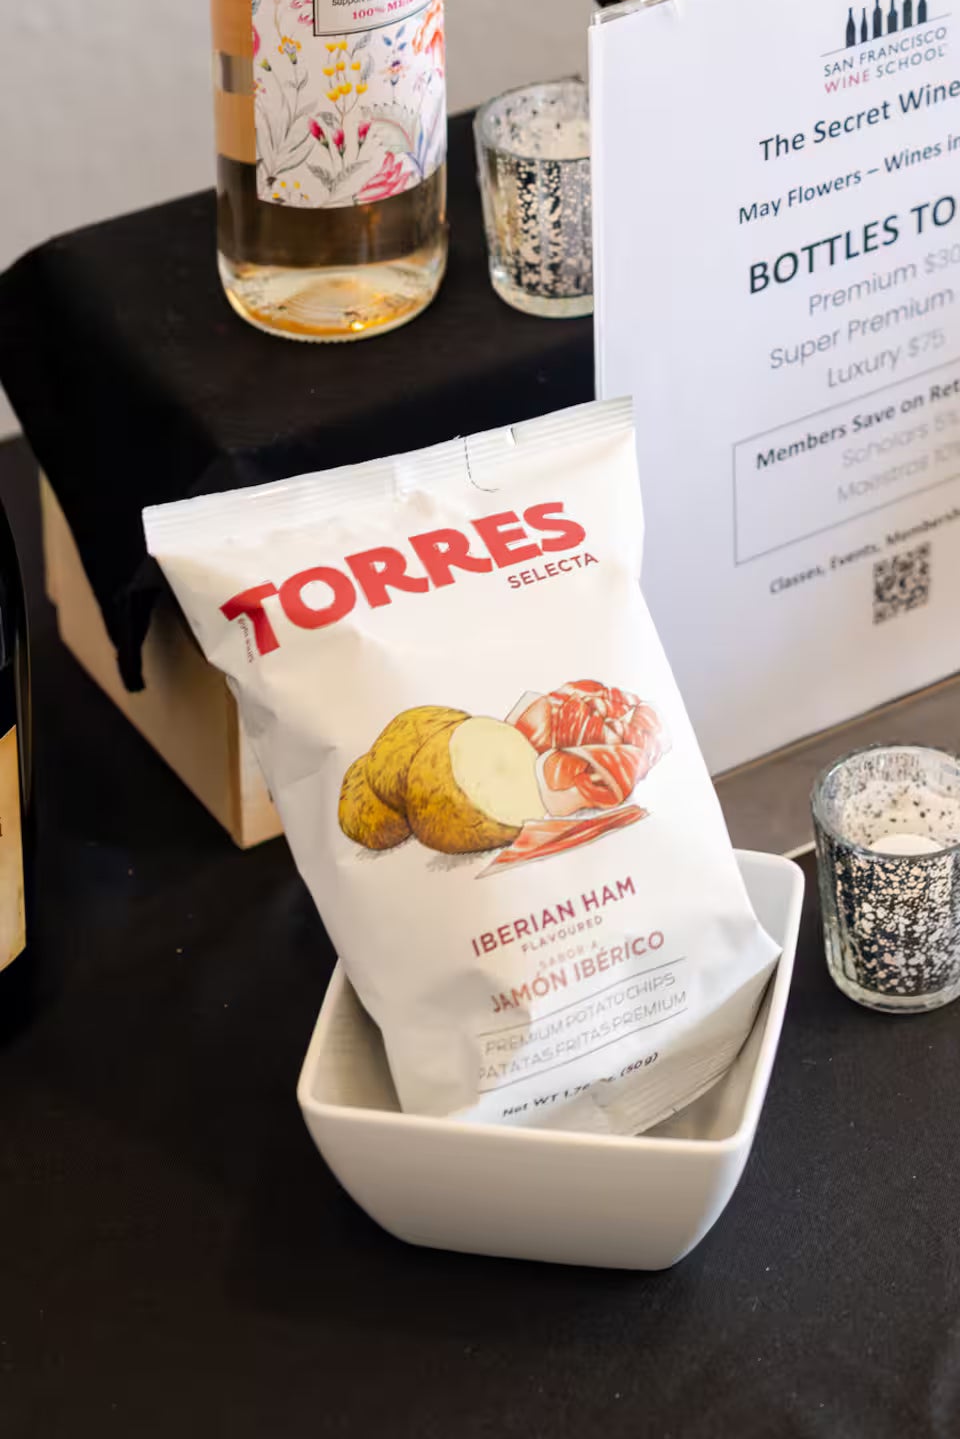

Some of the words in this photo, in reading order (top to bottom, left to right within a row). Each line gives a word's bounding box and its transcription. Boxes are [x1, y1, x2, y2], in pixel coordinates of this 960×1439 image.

[823, 57, 854, 77] SAN
[859, 26, 947, 66] FRANCISCO
[824, 70, 870, 94] WINE
[759, 132, 805, 161] The
[813, 100, 891, 144] Secret
[899, 78, 960, 114] Wine
[738, 197, 782, 224] May
[787, 170, 862, 208] Flowers
[884, 141, 942, 173] Wines
[749, 214, 899, 294] BOTTLES
[910, 195, 956, 235] TO
[808, 262, 917, 316] Premium
[769, 327, 840, 371] Super
[847, 287, 955, 341] Premium
[826, 343, 901, 388] Luxury
[907, 327, 946, 360] $75
[755, 426, 847, 470] Members
[852, 404, 896, 434] Save
[900, 393, 925, 416] on
[219, 501, 587, 657] TORRES
[507, 551, 600, 589] SELECTA
[769, 567, 826, 595] Classes,
[830, 543, 880, 570] Events,
[471, 899, 577, 958] IBERIAN
[581, 876, 637, 912] HAM
[521, 915, 604, 953] FLAVOURED
[490, 968, 569, 1013] JAMÓN
[573, 930, 666, 982] IBÉRICO
[538, 944, 586, 970] SABOR
[478, 1045, 555, 1081] PATATAS
[555, 1024, 612, 1054] FRITAS
[612, 990, 688, 1031] PREMIUM
[484, 1019, 564, 1056] PREMIUM
[626, 971, 677, 1001] CHIPS
[533, 1092, 560, 1108] WT
